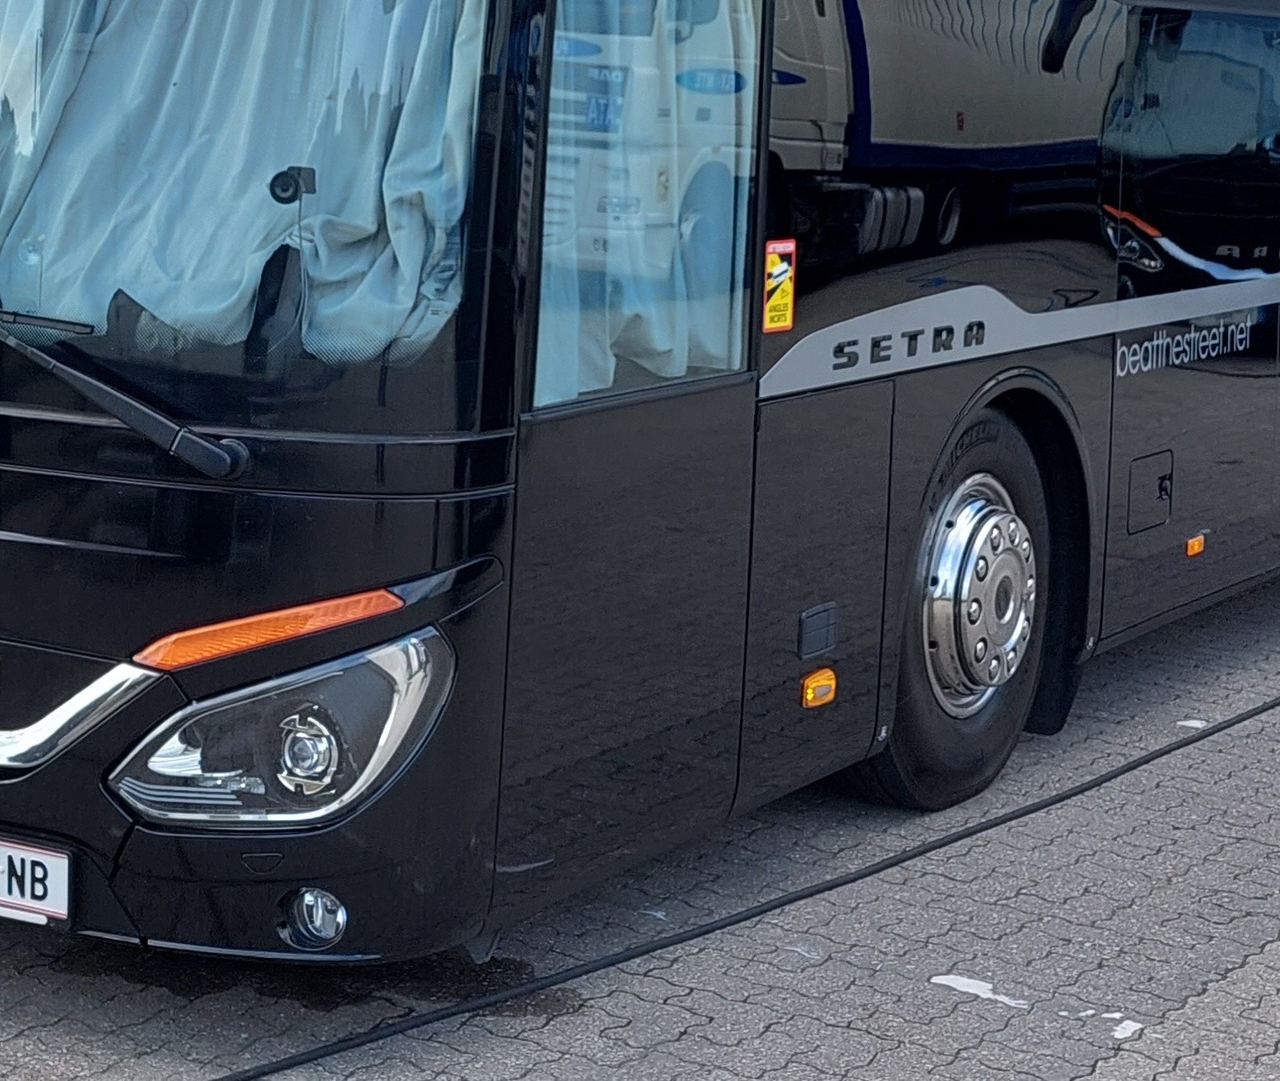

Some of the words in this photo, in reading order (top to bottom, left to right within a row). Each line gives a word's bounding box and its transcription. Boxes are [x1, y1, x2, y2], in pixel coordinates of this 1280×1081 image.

[832, 320, 986, 371] SETRA
[1116, 314, 1255, 377] beatthestreet.net
[7, 854, 49, 901] NB
